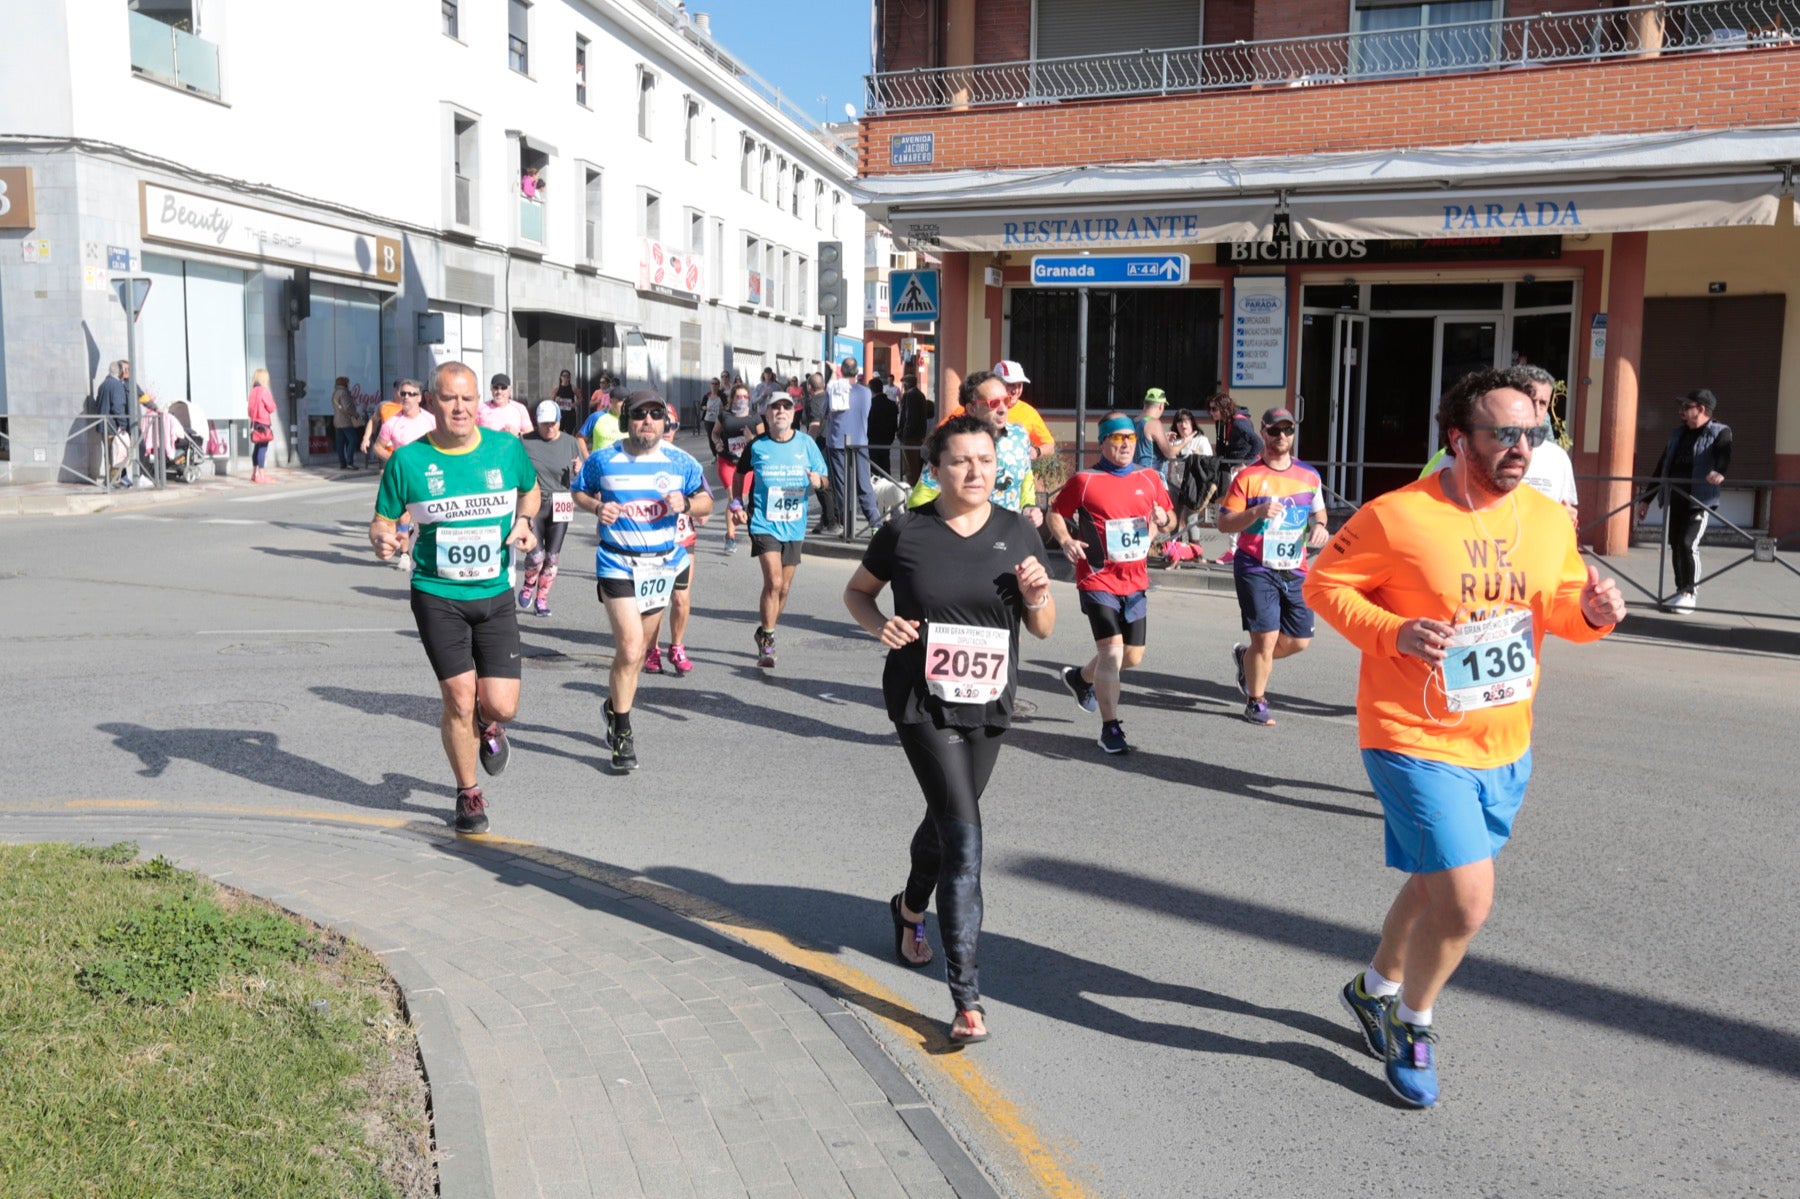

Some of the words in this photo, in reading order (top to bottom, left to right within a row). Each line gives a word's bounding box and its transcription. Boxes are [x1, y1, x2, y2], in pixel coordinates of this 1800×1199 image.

[902, 135, 932, 143] AVENIDA
[904, 144, 929, 153] JACOBO
[894, 153, 932, 163] CAMARERO
[160, 194, 233, 244] Beauty
[244, 226, 268, 242] THE
[272, 233, 302, 248] SHOP
[1442, 200, 1582, 230] PARADA
[1003, 214, 1198, 245] RESTAURANTE
[383, 245, 395, 273] B
[1230, 240, 1368, 260] BICHITOS
[1036, 265, 1095, 277] Granada
[428, 500, 460, 514] CAJA
[465, 496, 508, 508] RURAL
[445, 508, 492, 519] GRANADA
[626, 502, 658, 518] DANI
[774, 498, 799, 511] 465
[1121, 531, 1140, 548] 64
[448, 544, 490, 564] 690
[1276, 543, 1296, 557] 63
[1464, 539, 1512, 568] WE
[641, 578, 666, 596] 670
[1461, 572, 1526, 603] RUN
[951, 627, 965, 635] GRAN
[931, 648, 1005, 680] 2057
[1462, 642, 1525, 681] 136
